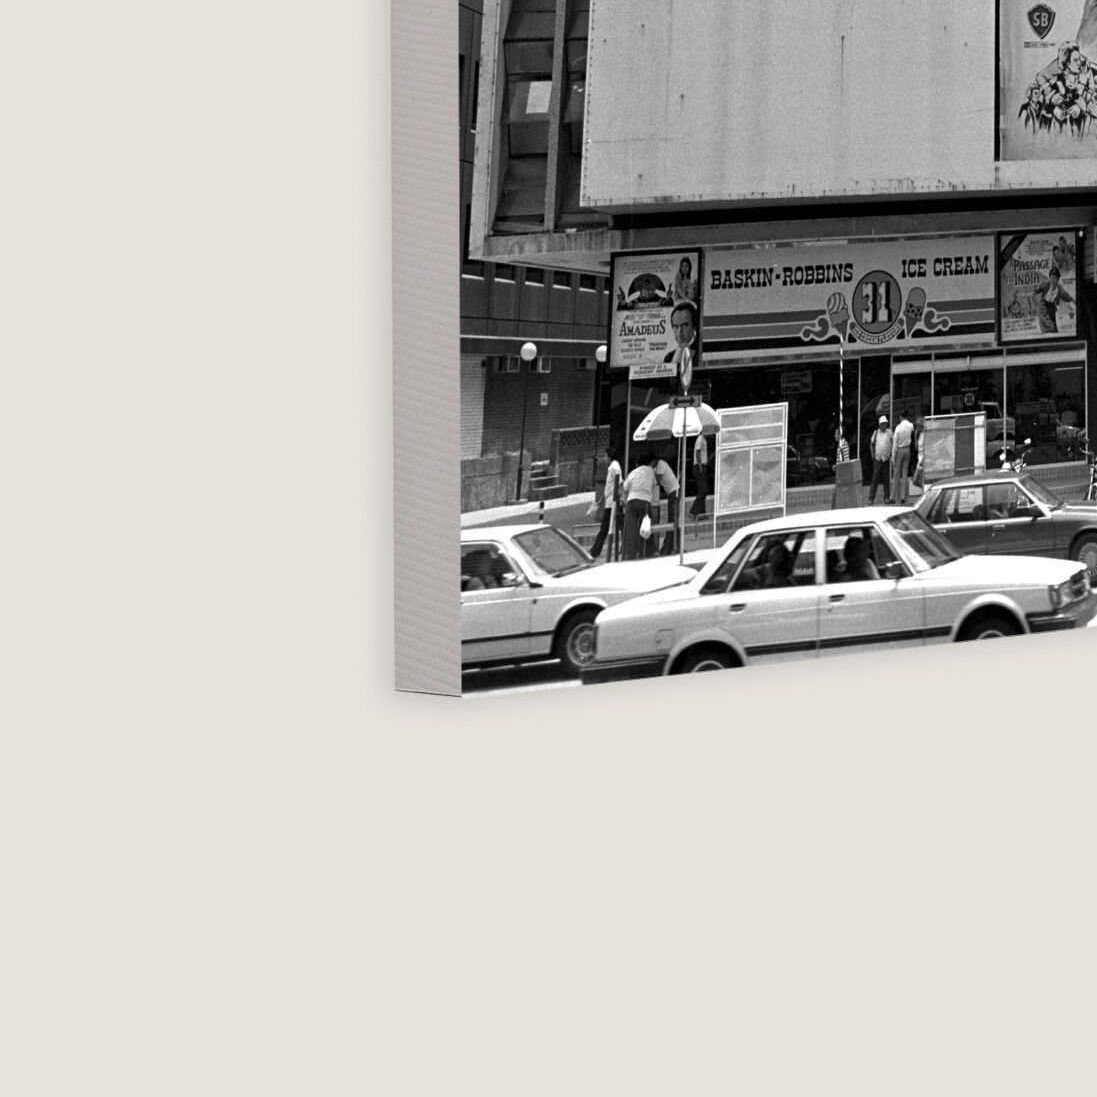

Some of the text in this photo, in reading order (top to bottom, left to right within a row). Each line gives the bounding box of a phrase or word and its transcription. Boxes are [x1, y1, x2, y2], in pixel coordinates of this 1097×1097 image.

[1033, 12, 1049, 27] SB
[901, 255, 989, 278] ICE CREAM
[1014, 258, 1051, 272] PASSAGE
[710, 263, 854, 290] BASKIN-ROBBINS
[1014, 272, 1040, 286] INDIA
[861, 281, 893, 324] 31
[619, 319, 666, 336] AMADEUS
